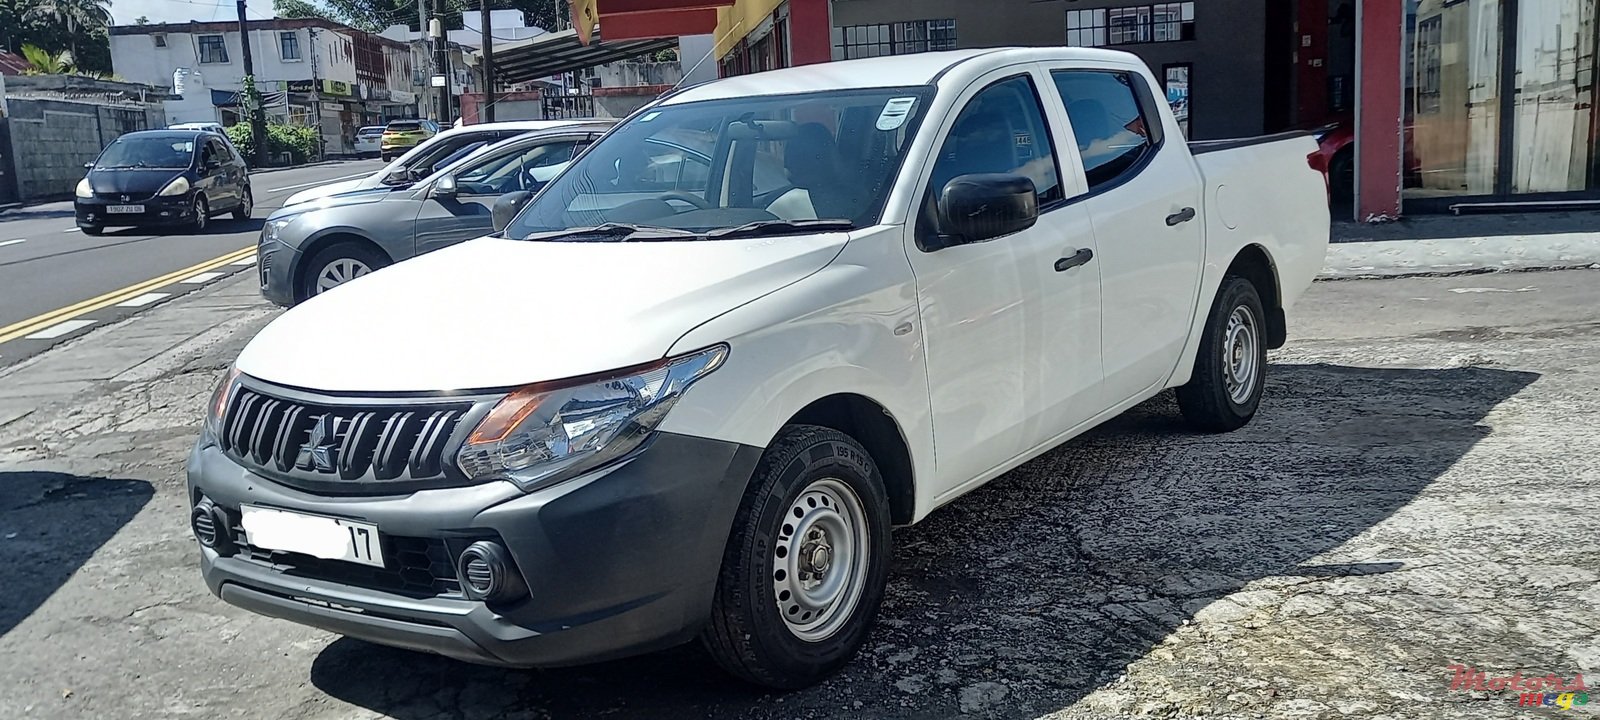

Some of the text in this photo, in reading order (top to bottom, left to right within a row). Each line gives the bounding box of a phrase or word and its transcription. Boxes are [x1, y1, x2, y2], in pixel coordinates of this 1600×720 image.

[836, 445, 849, 458] 195
[850, 450, 856, 461] R
[856, 454, 864, 466] 15
[348, 526, 372, 561] 17
